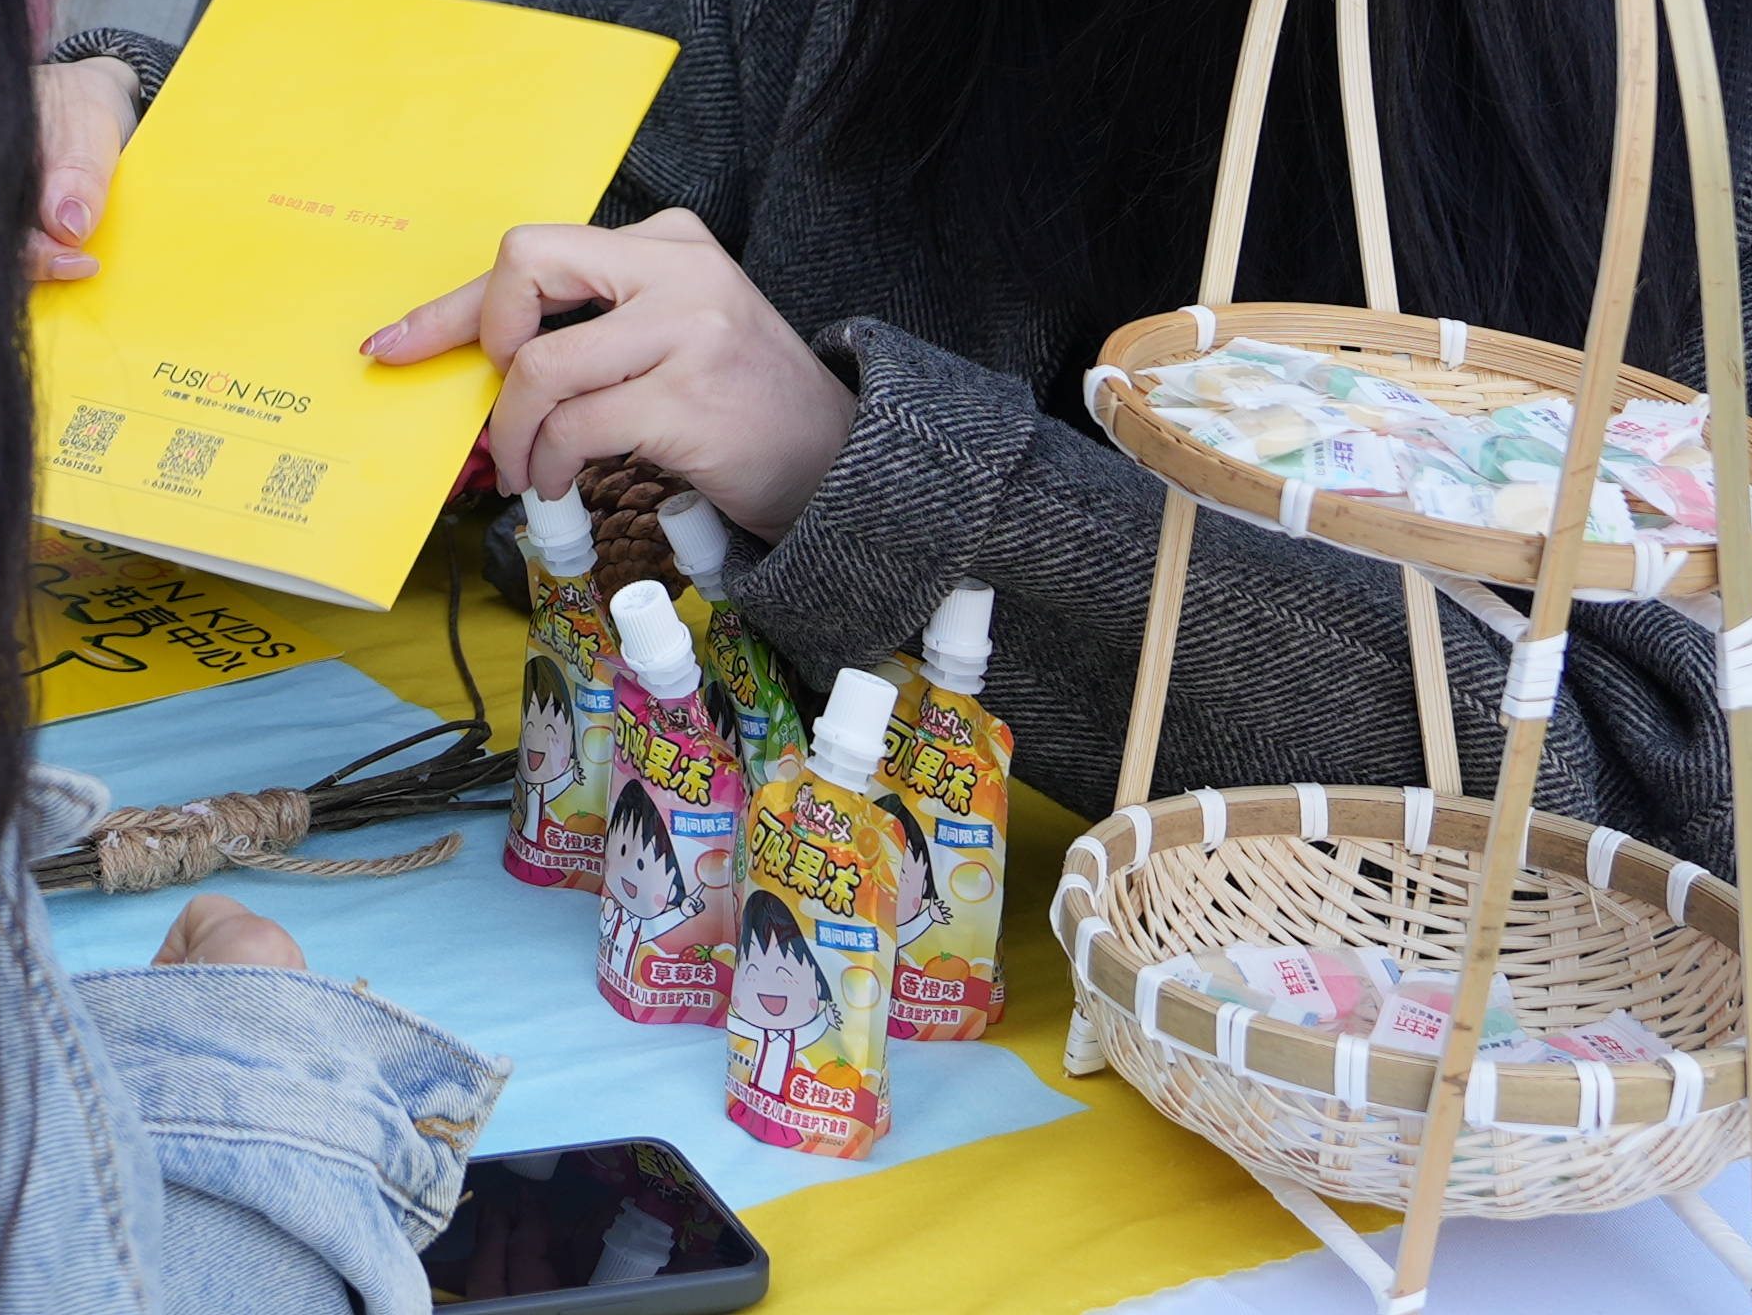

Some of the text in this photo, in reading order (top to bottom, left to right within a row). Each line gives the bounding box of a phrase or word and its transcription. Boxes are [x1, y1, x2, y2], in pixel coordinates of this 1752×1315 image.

[344, 209, 410, 232] 托付于爱
[152, 361, 311, 414] FUSION KIDS
[88, 584, 248, 673] 托育中心
[189, 607, 296, 659] KIDS
[615, 701, 714, 807] 可吸果冻
[672, 815, 734, 835] 期间限定
[937, 825, 990, 845] 期间限定
[546, 827, 604, 853] 香橙味
[749, 806, 862, 918] 可吸果冻
[818, 926, 875, 950] 期间限定
[651, 961, 717, 985] 草莓味
[900, 973, 964, 1001] 香橙味
[791, 1077, 855, 1110] 香橙味
